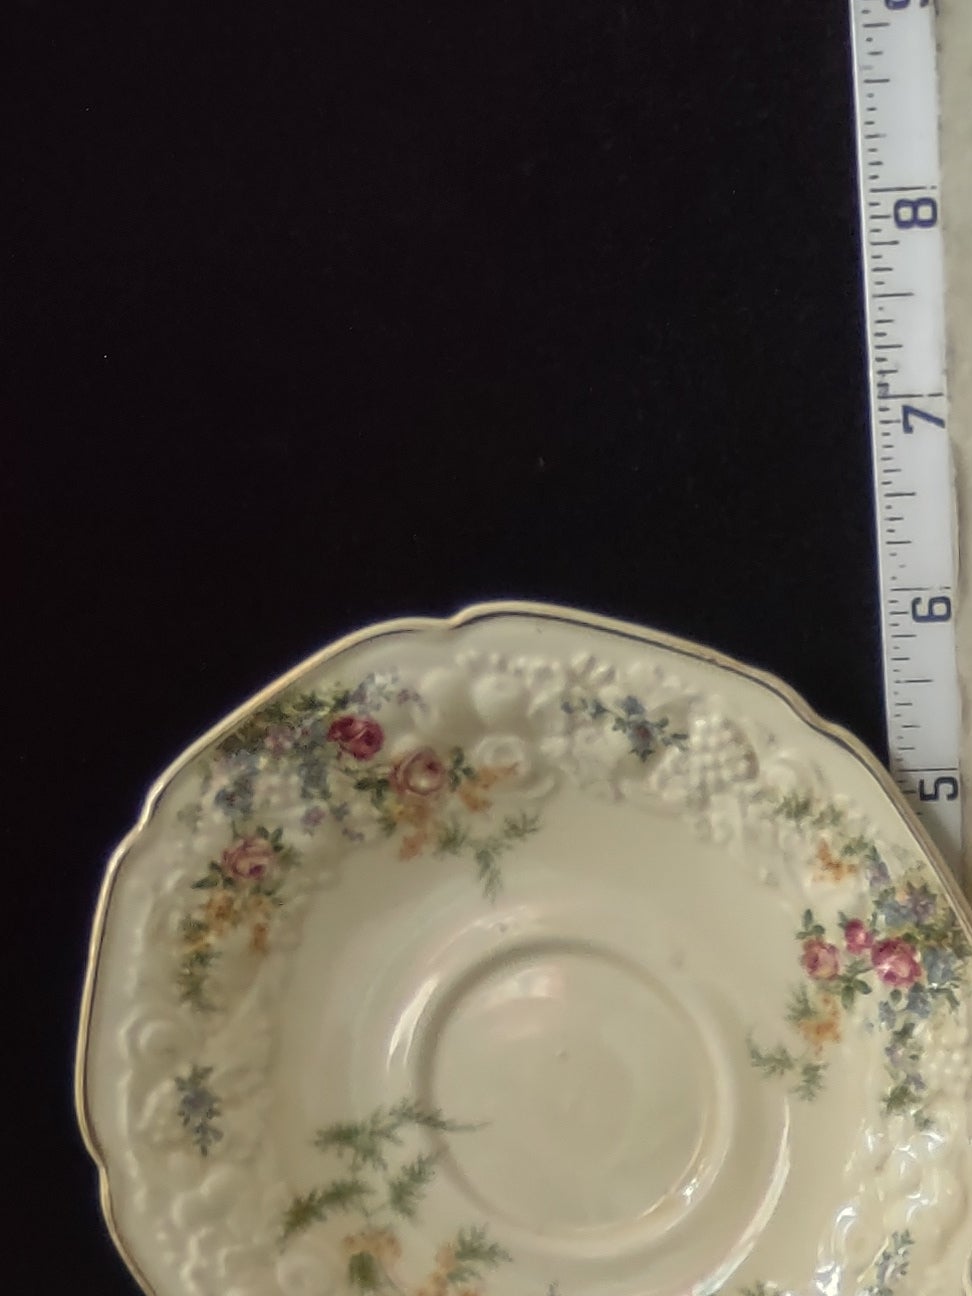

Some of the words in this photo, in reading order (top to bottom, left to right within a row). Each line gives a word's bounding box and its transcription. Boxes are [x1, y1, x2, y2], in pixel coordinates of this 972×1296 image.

[893, 197, 938, 229] 8
[901, 405, 945, 434] 7
[911, 596, 952, 623] 6
[918, 776, 959, 801] 5
